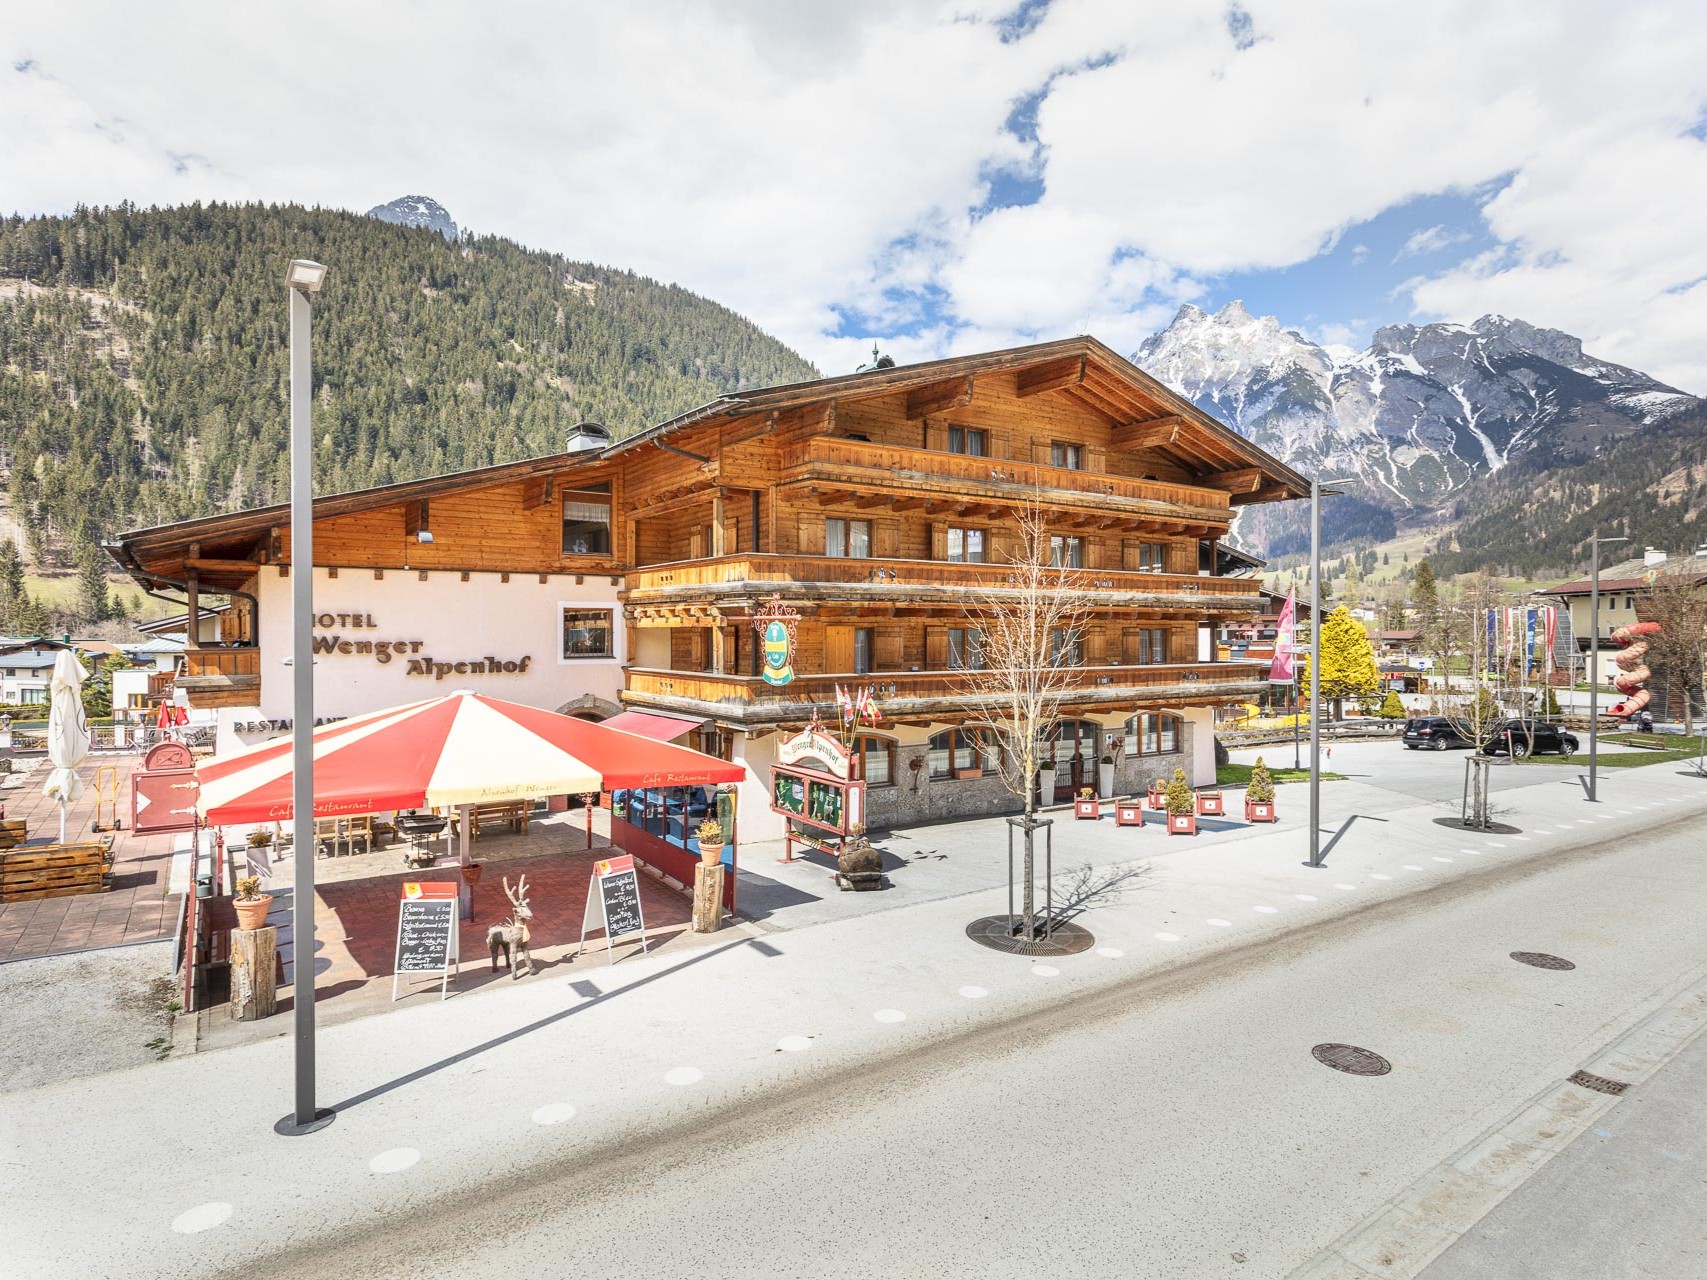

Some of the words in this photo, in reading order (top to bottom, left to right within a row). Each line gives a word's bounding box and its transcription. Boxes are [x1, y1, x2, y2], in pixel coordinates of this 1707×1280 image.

[312, 613, 377, 628] OTEL
[312, 635, 423, 663] Wenger
[406, 655, 531, 680] Alpenhof
[233, 716, 348, 733] RESTAAN
[269, 803, 295, 819] Caf
